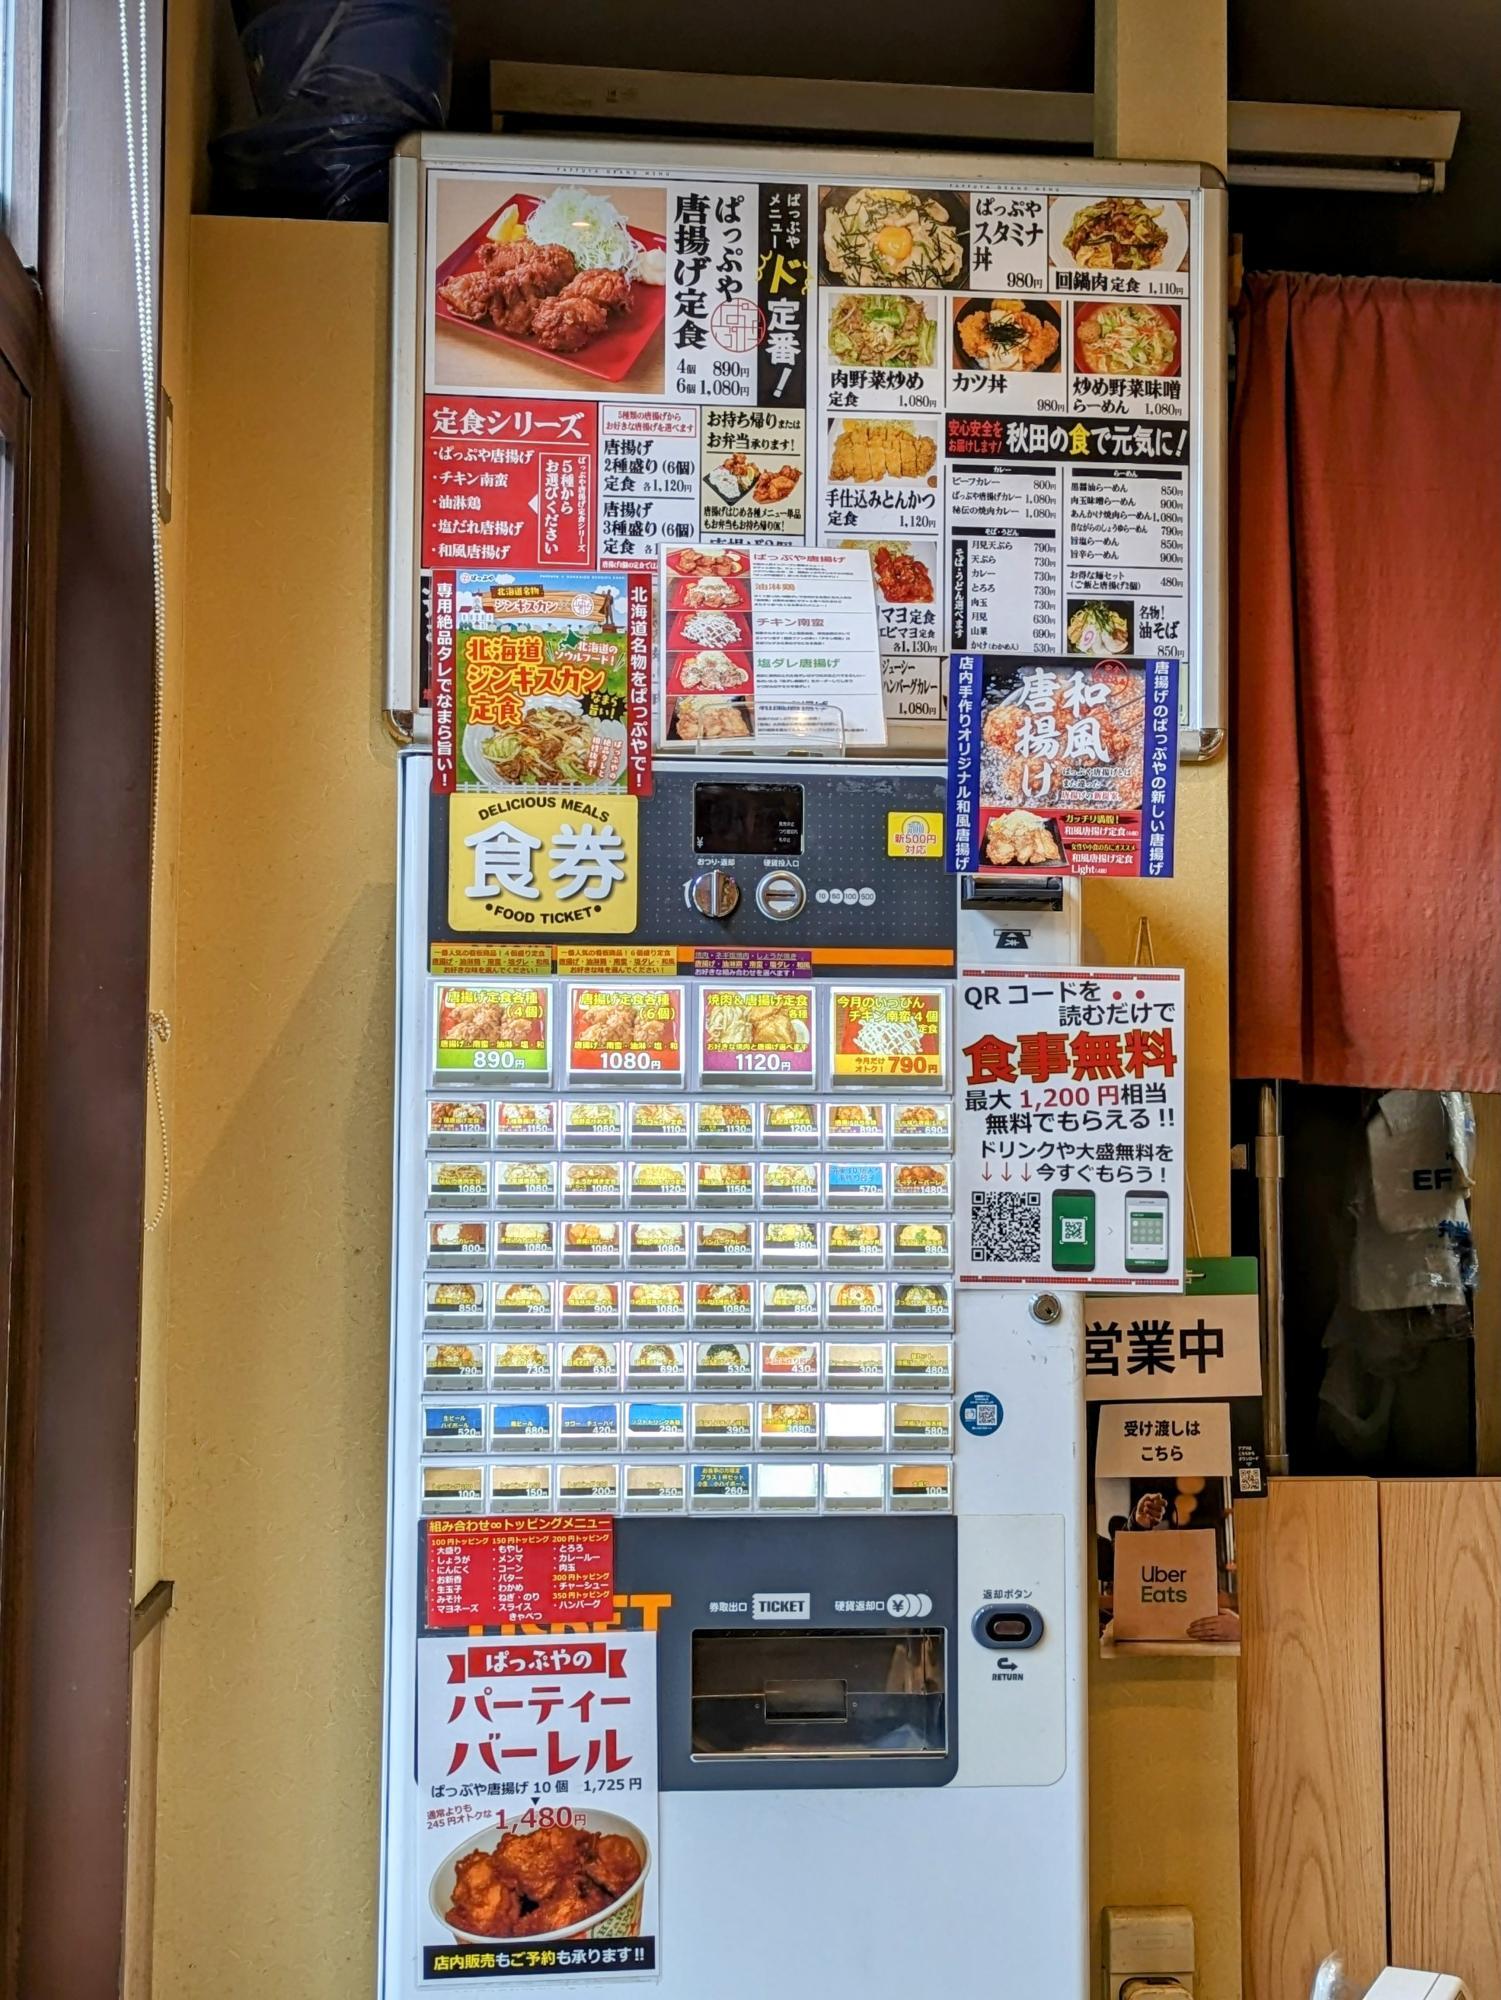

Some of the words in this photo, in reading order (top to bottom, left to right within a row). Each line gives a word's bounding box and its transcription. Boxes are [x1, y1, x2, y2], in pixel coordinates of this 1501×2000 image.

[975, 197, 1042, 217] ぱっぷや
[768, 195, 782, 249] メニュー
[973, 221, 1044, 248] スタミナ
[714, 194, 745, 302] ぱっぷや
[973, 247, 993, 272] 丼
[673, 192, 710, 350] 唐揚げ定食
[1006, 272, 1043, 290] 980円
[1147, 279, 1184, 297] 1,110円
[676, 360, 697, 376] 4個
[712, 360, 750, 378] 890円
[676, 379, 697, 395] 6個
[699, 379, 750, 398] 1,080円
[830, 371, 925, 392] 肉野菜炒め
[953, 372, 1008, 394] カツ丼
[1073, 376, 1182, 401] 炒め野菜味噌
[829, 391, 859, 408] 定食
[898, 394, 937, 409] 1,080円
[1036, 398, 1066, 414] 980円
[1072, 399, 1130, 416] らーめん
[1145, 401, 1183, 417] 1,080円
[432, 406, 585, 440] 定食シリーズ
[947, 420, 1002, 438] 安心安全を
[604, 438, 654, 456] 唐揚げ
[1006, 421, 1186, 458] 秋田の食で元気に！
[604, 457, 657, 475] 2種盛り
[561, 459, 575, 516] 5種から
[604, 475, 636, 493] 定食
[951, 477, 1001, 487] ビーフカレー
[544, 459, 559, 555] お選びください
[825, 488, 936, 510] 手仕込みとんかつ
[603, 500, 654, 518] 唐揚げ
[603, 519, 657, 538] 3種盛り
[828, 511, 858, 527] 定食
[899, 513, 936, 529] 1,120円
[603, 537, 635, 555] 定食
[971, 568, 997, 578] カレー
[971, 583, 996, 593] とろろ
[494, 599, 559, 613] ジンギスカン
[1139, 620, 1180, 640] 油そば
[466, 636, 544, 665] 北海道
[756, 657, 841, 669] 塩ダレ唐揚げ
[436, 583, 453, 787] 専用絶品タレでなまら旨い！
[466, 664, 605, 696] ジンギスカン
[630, 586, 648, 787] 北海道名物をぱっぷやで！
[467, 692, 524, 725] 定食
[1063, 670, 1112, 763] 和風
[955, 656, 974, 871] 店内手作りオリジナル和風唐揚げ
[1148, 661, 1170, 876] 唐揚げのぱっぷやの新しい唐揚げ
[478, 796, 557, 822] DELICIOUS
[560, 799, 611, 823] MEALS
[904, 845, 927, 855] 対応
[463, 820, 626, 901] 食券
[493, 904, 536, 925] FOOD
[539, 905, 593, 926] TICKET
[447, 990, 538, 1006] 唐揚げ定食各種
[580, 991, 670, 1006] 唐揚げ定食各種
[837, 996, 926, 1011] 今月のいっぴん
[964, 986, 1001, 1010] QR
[1008, 981, 1101, 1006] コードを
[788, 1008, 808, 1019] 各種
[1059, 1002, 1176, 1028] 読むだけで
[918, 1024, 939, 1035] 定食
[473, 1051, 526, 1069] 890円
[600, 1052, 662, 1070] 1080円
[734, 1053, 791, 1072] 1120円
[888, 1055, 938, 1074] 790円
[962, 1027, 1178, 1086] 食事無料
[965, 1089, 1012, 1112] 最大
[981, 1140, 1174, 1163] ドリンクや大盛無料を
[1036, 1163, 1167, 1184] 今すぐもらう！
[1085, 1318, 1225, 1377] 営業中
[1123, 1419, 1201, 1438] 受け渡しは
[1140, 1446, 1185, 1463] こちら
[498, 1554, 523, 1563] メンマ
[498, 1564, 524, 1573] コーン
[1141, 1565, 1187, 1584] Uber
[982, 1588, 1033, 1600] 返却ボタン
[1141, 1586, 1188, 1604] Eats
[498, 1602, 532, 1611] スライス
[708, 1602, 748, 1613] 券取出口
[758, 1600, 806, 1614] TICKET
[834, 1600, 886, 1612] 硬貨返却口
[485, 1649, 594, 1672] ぱっぷやの
[991, 1673, 1024, 1682] RETURN
[447, 1686, 631, 1724] パーティー
[446, 1729, 634, 1777] バーレル
[426, 1803, 473, 1820] 通常よりも
[494, 1805, 588, 1836] 1,480円
